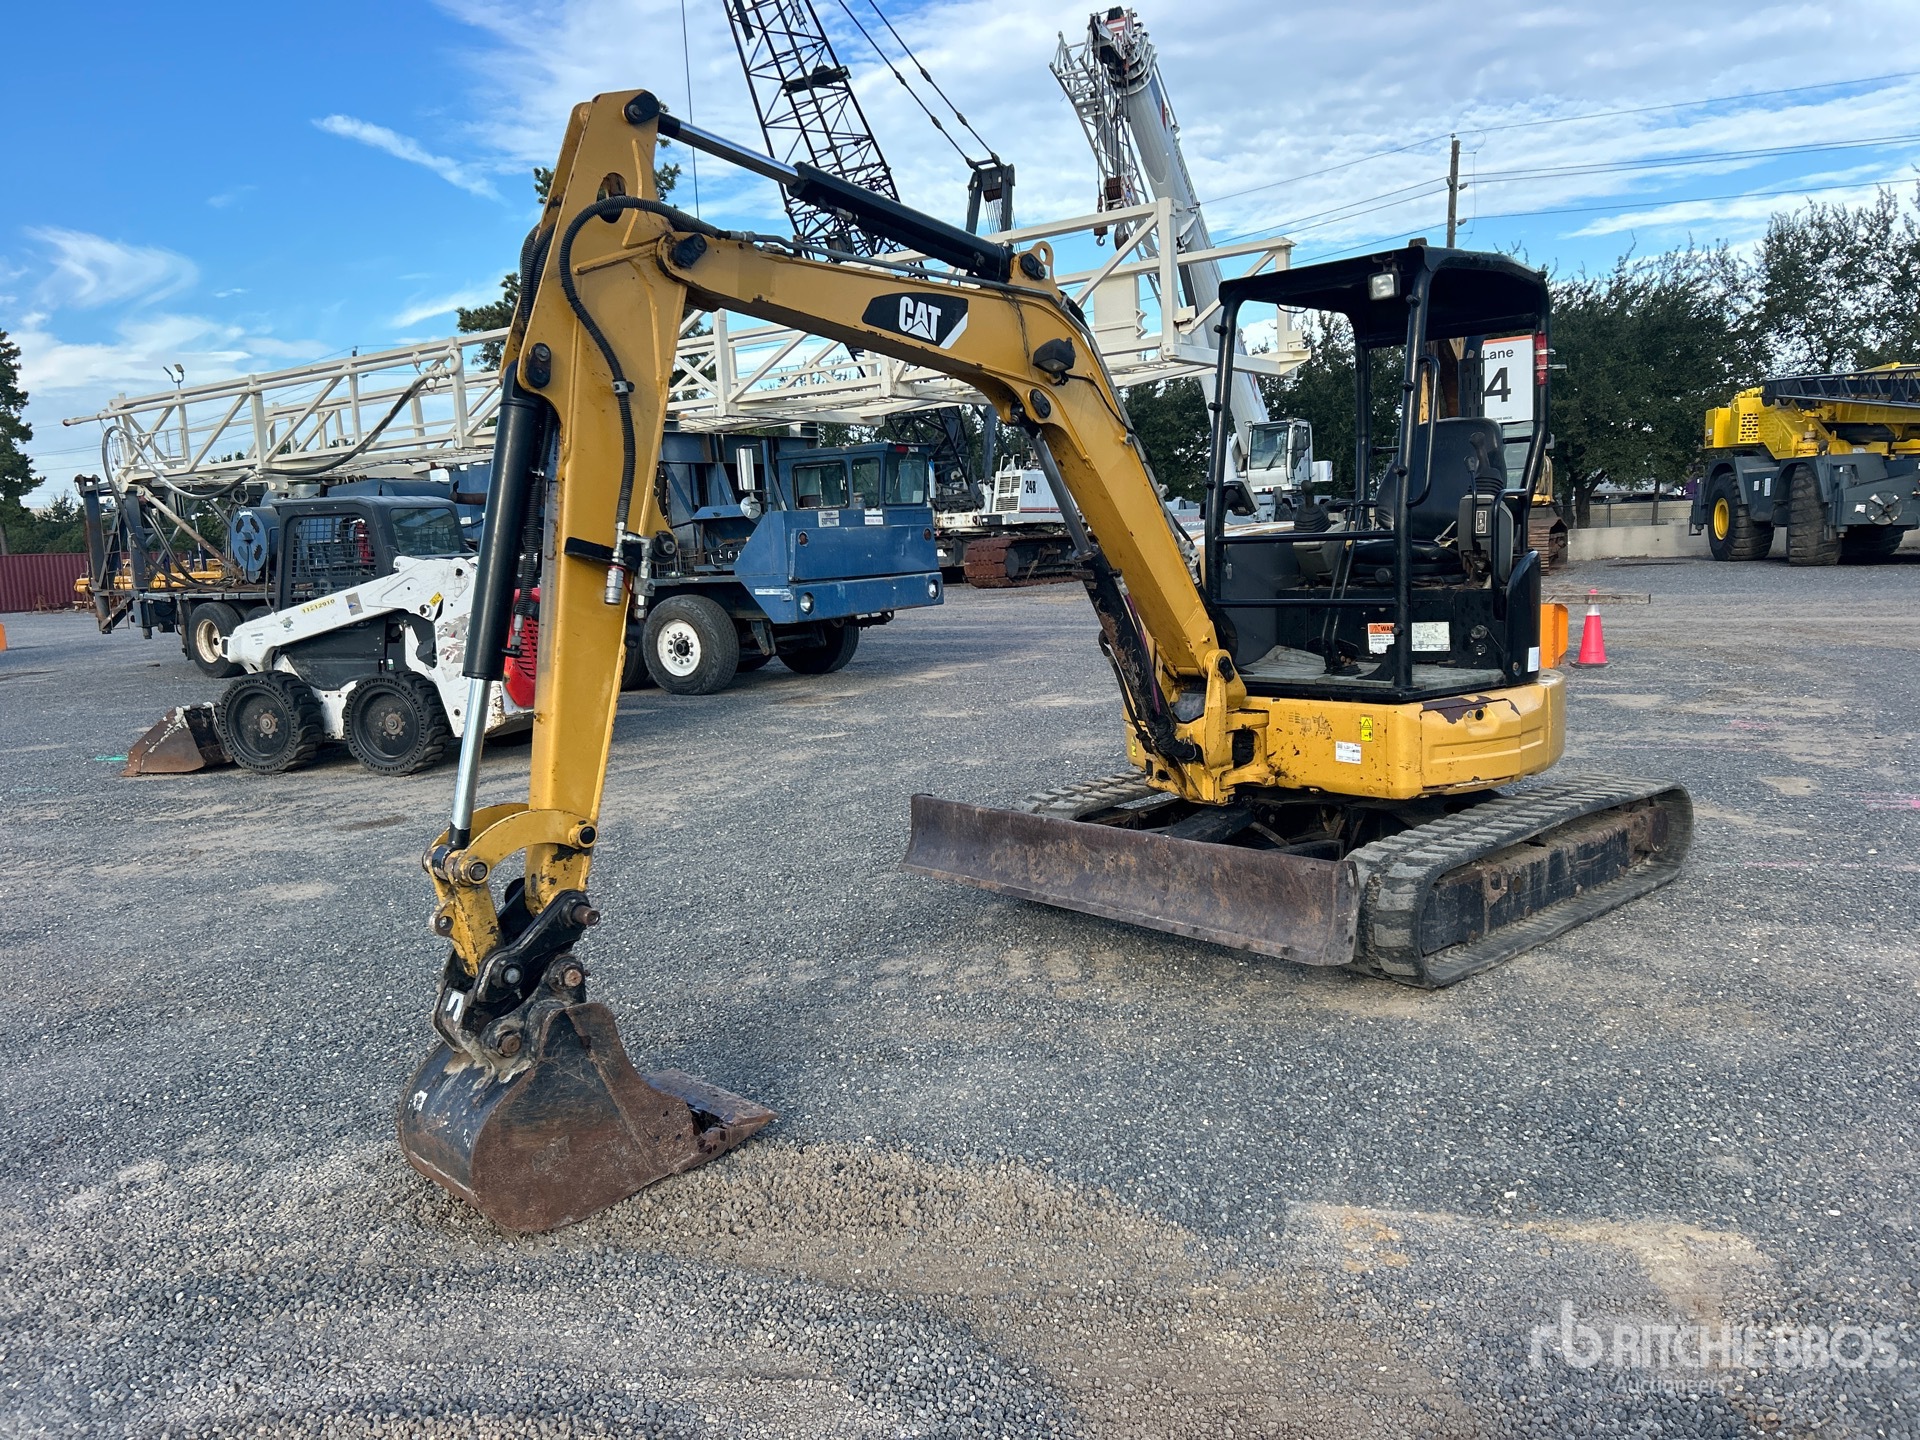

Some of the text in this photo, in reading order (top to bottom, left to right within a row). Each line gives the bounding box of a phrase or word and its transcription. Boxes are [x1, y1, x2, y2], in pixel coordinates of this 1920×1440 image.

[898, 296, 942, 342] CAT
[1482, 348, 1514, 361] Lane
[1483, 366, 1512, 403] 4
